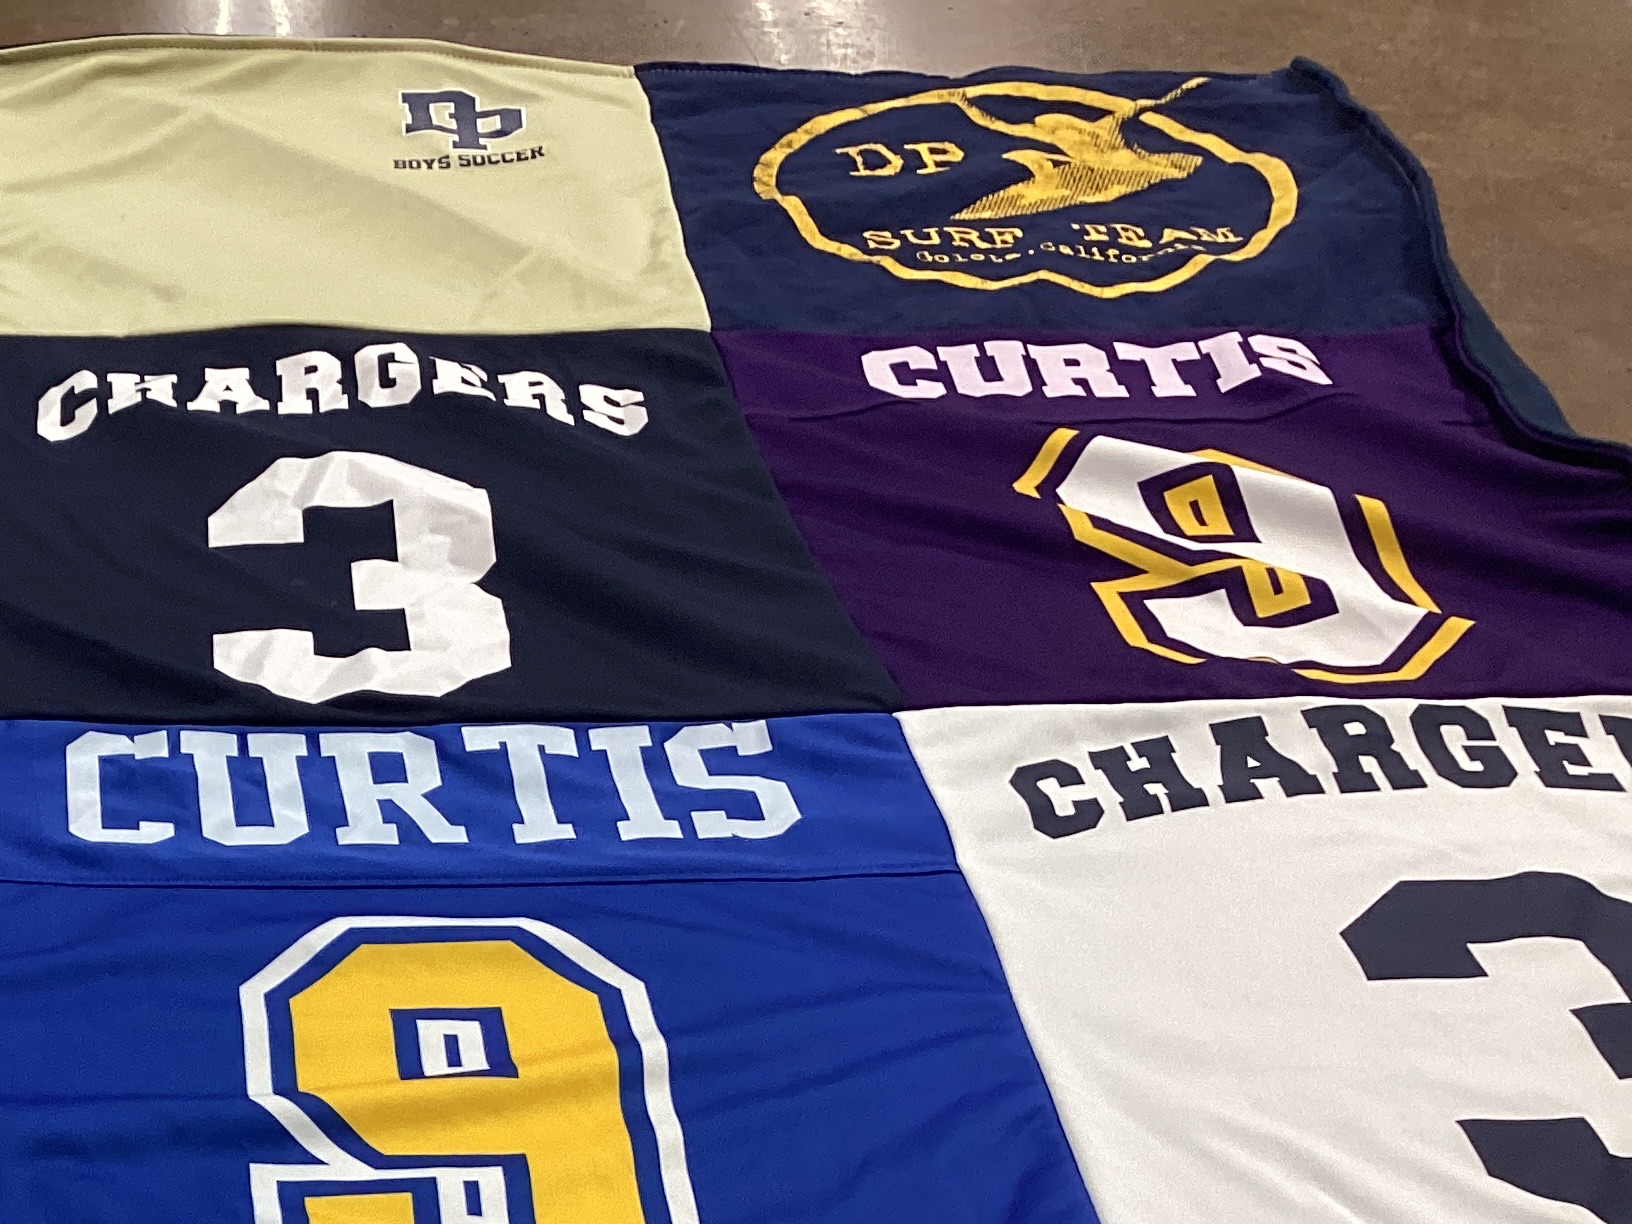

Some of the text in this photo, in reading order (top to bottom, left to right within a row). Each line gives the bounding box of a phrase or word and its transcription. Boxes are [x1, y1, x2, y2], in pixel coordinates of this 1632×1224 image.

[394, 146, 545, 169] BOYS SOCCER
[834, 141, 965, 177] DP
[862, 227, 1024, 250] SURF
[37, 342, 649, 443] CHARGERS
[861, 331, 1333, 400] CURTIS
[208, 451, 512, 704] 3
[1012, 428, 1475, 684] 9
[65, 722, 802, 846] CURTIS
